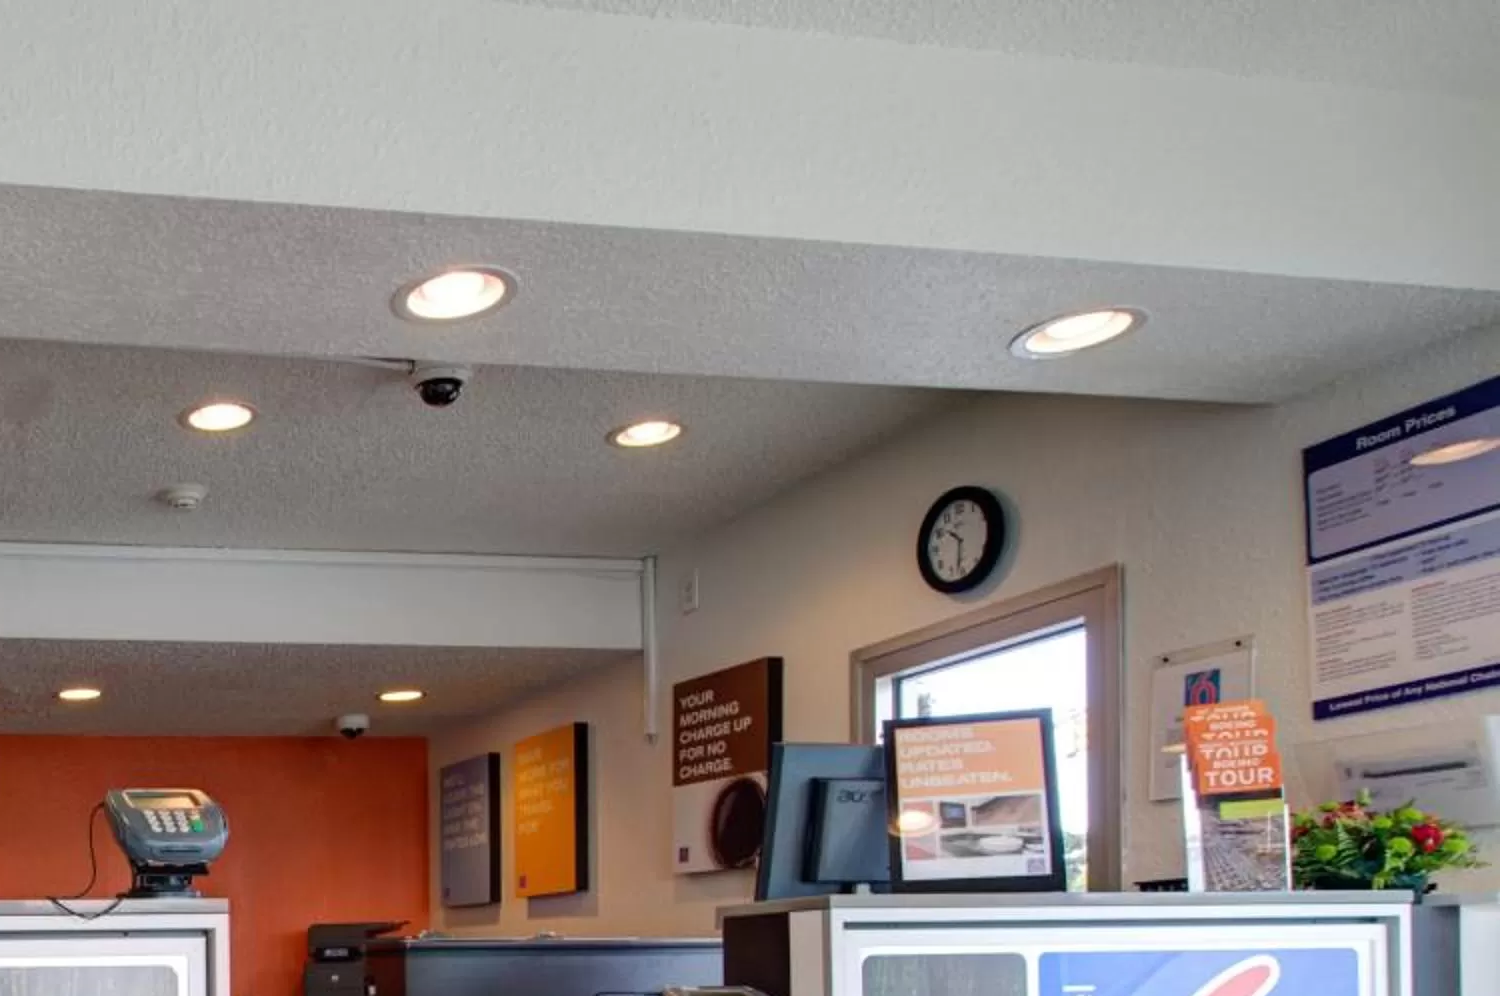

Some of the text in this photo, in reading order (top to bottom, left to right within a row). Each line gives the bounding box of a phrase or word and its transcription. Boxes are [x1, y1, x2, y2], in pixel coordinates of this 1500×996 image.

[1355, 404, 1457, 451] Room Prices
[679, 689, 714, 709] YOUR
[679, 700, 740, 727] MORNING
[679, 715, 752, 745] CHARGE UP
[679, 740, 727, 761] FOR NO
[1203, 766, 1275, 787] TOUR
